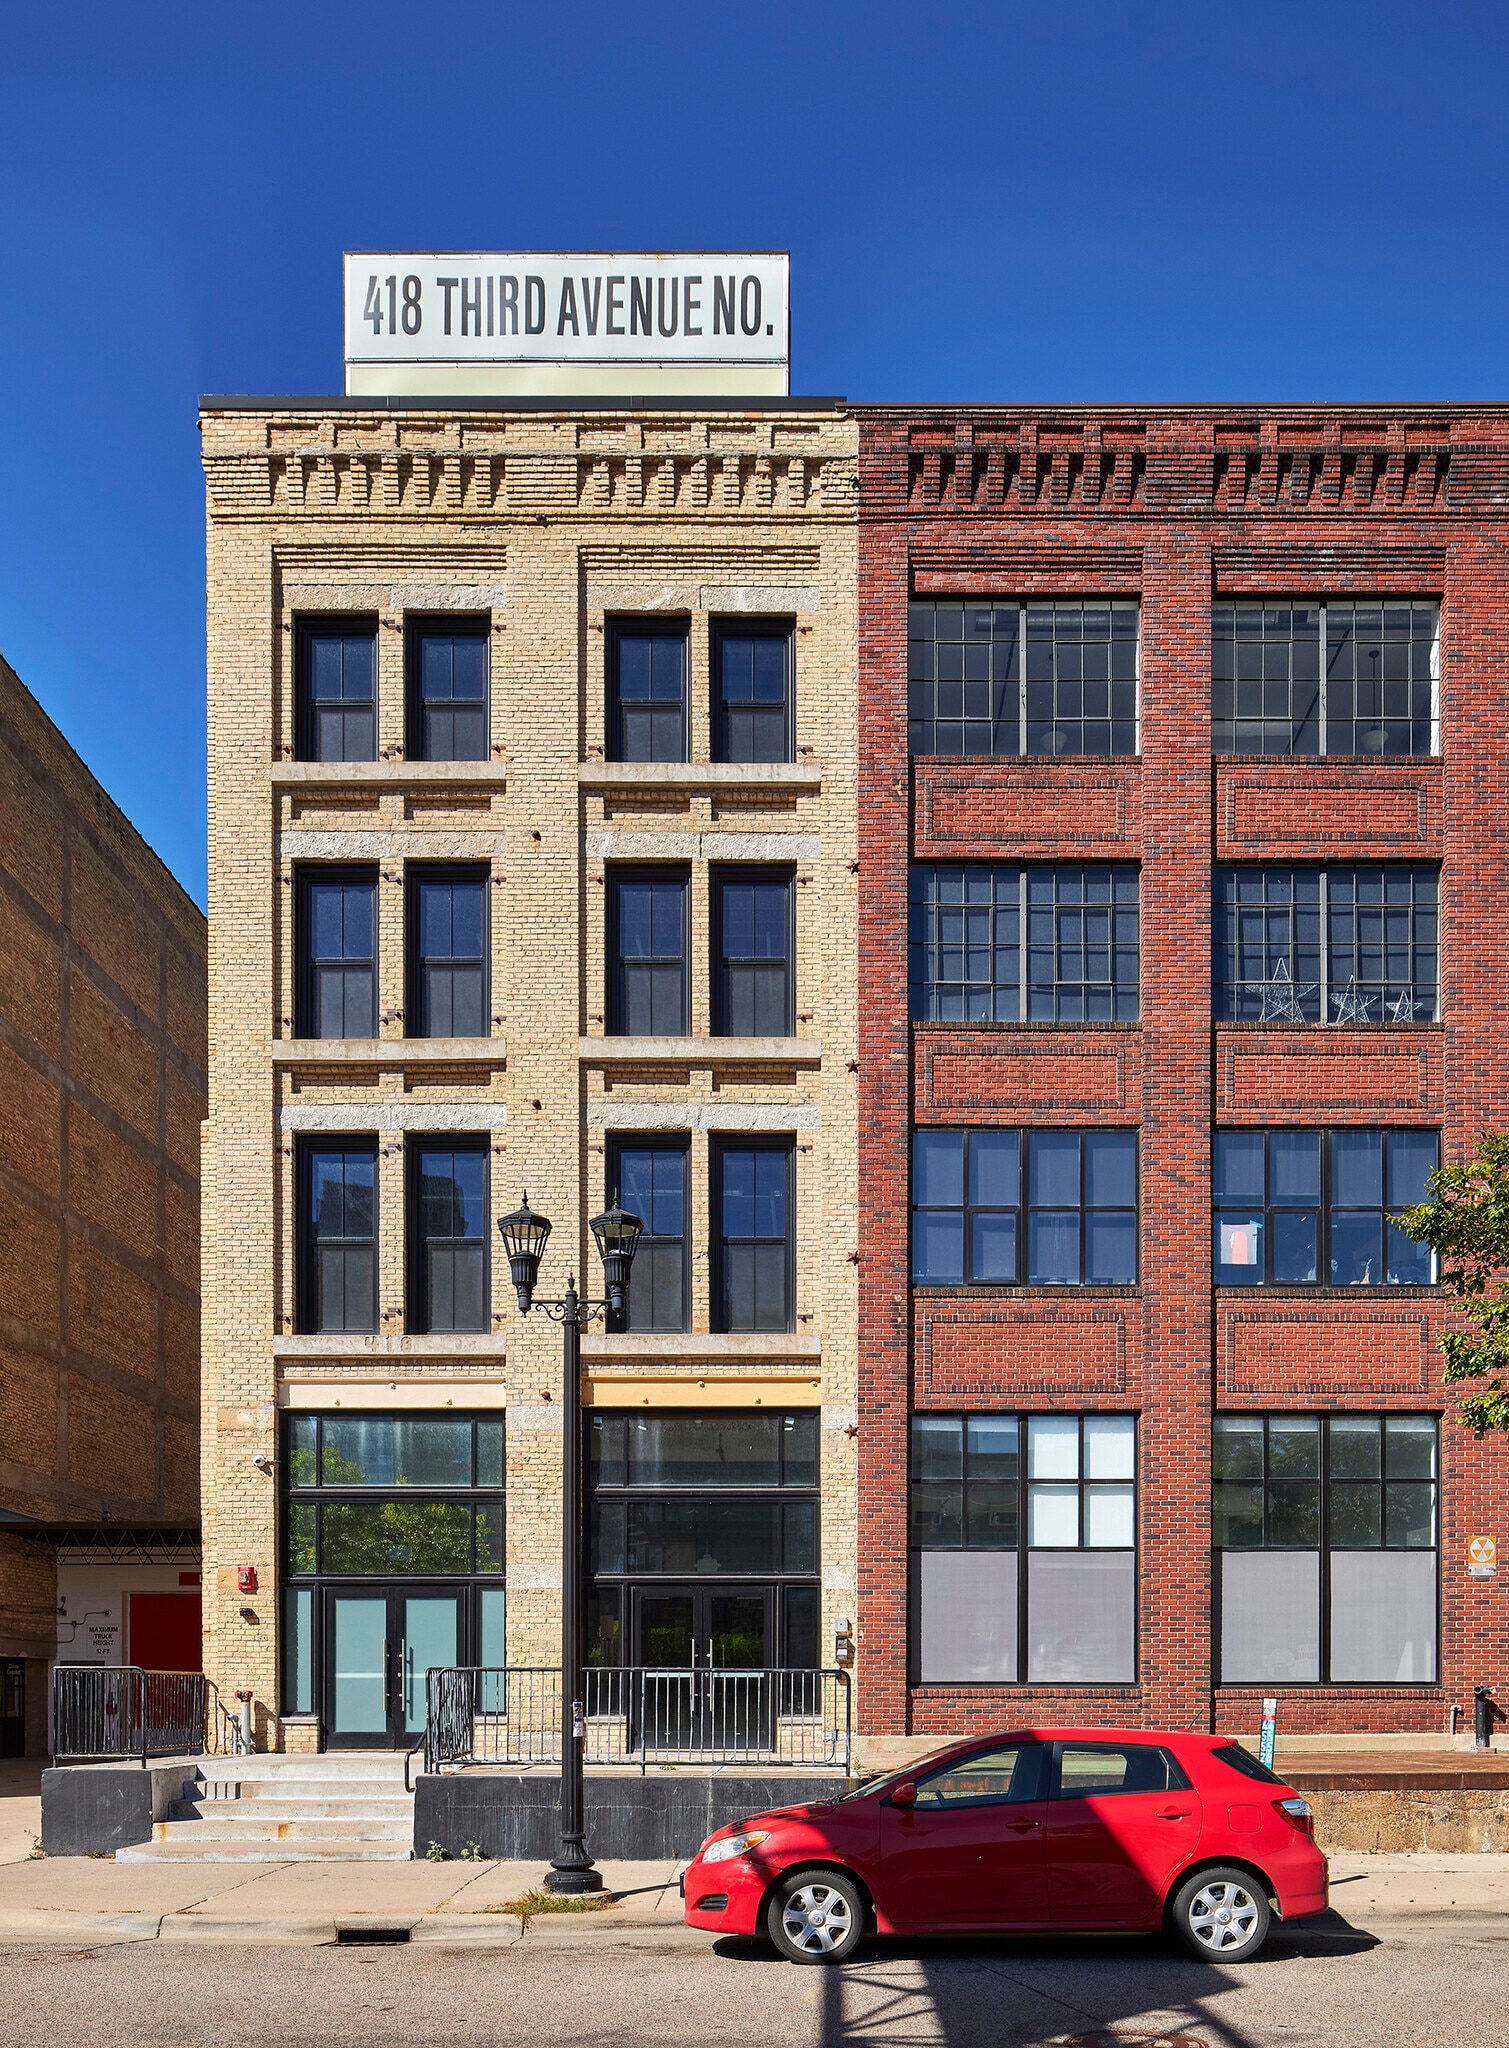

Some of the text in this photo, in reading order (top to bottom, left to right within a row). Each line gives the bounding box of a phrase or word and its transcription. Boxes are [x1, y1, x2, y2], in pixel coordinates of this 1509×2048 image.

[363, 274, 774, 338] 418 THIRD AVENUE NO.
[364, 1335, 413, 1353] 418
